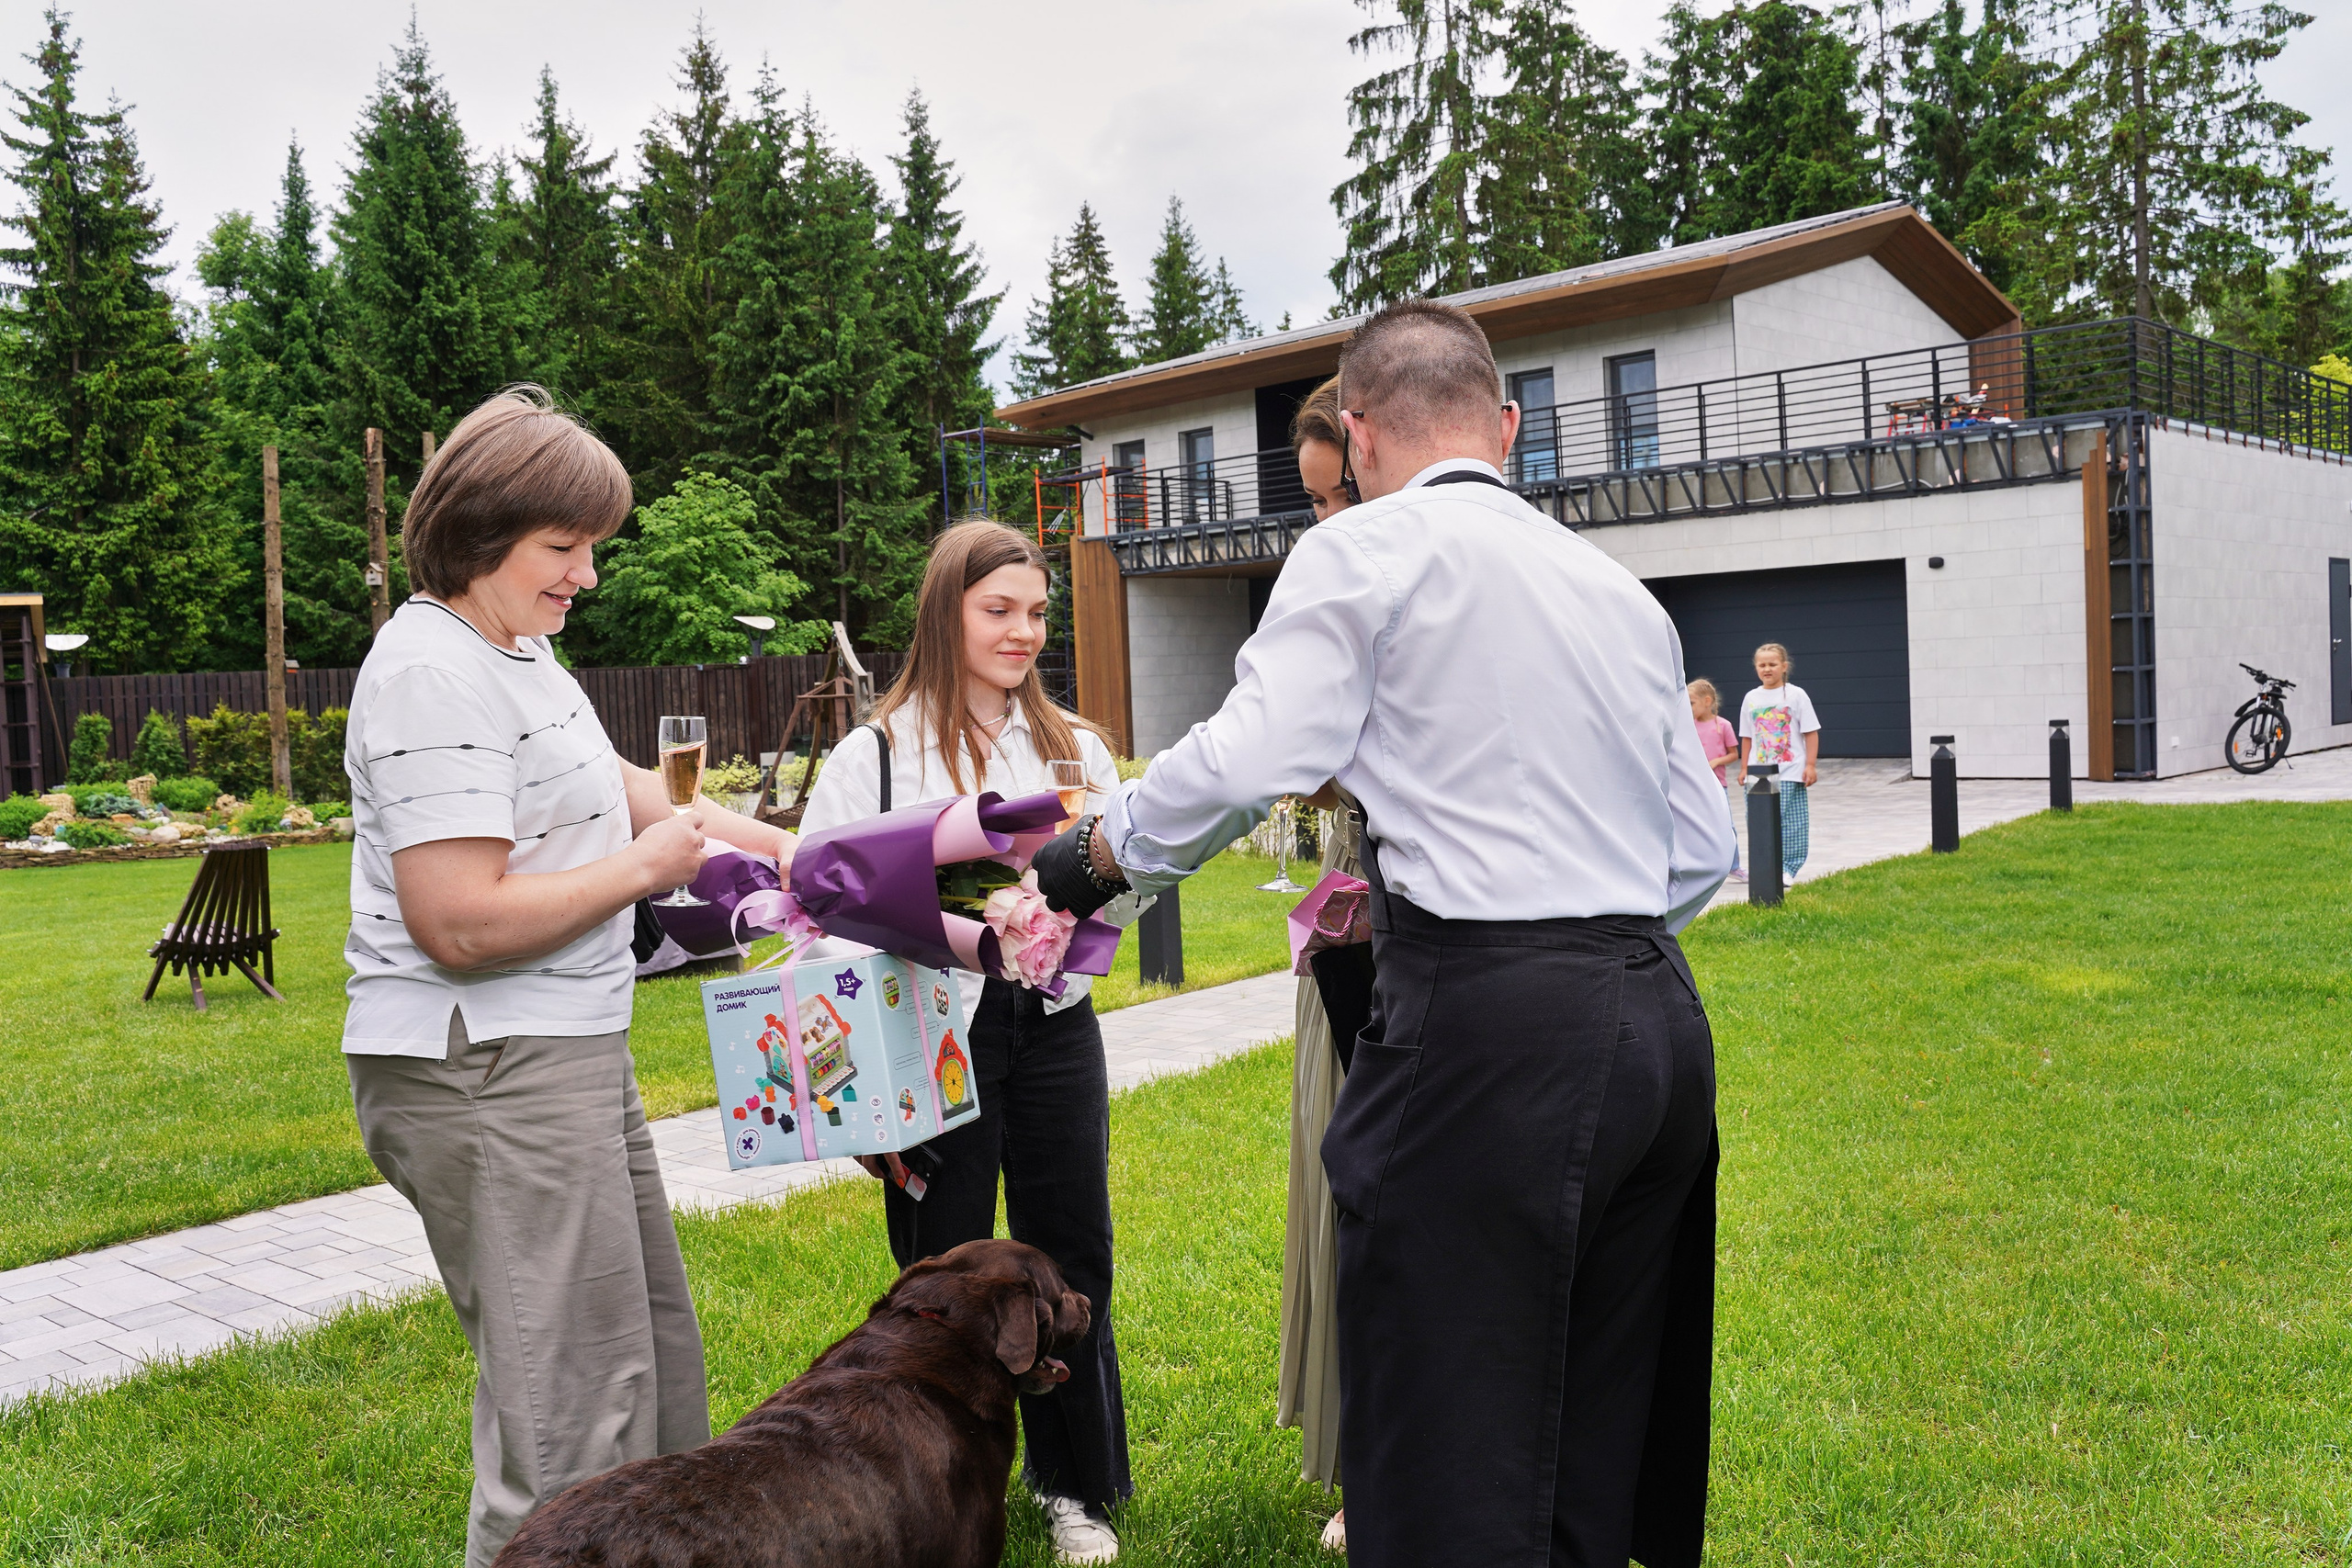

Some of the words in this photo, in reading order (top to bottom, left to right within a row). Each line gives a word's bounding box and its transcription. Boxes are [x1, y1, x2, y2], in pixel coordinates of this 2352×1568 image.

[839, 977, 856, 987] 1,5+
[714, 983, 781, 1000] РАЗВИВАЮЩИЙ
[717, 1001, 747, 1013] ДОМИК
